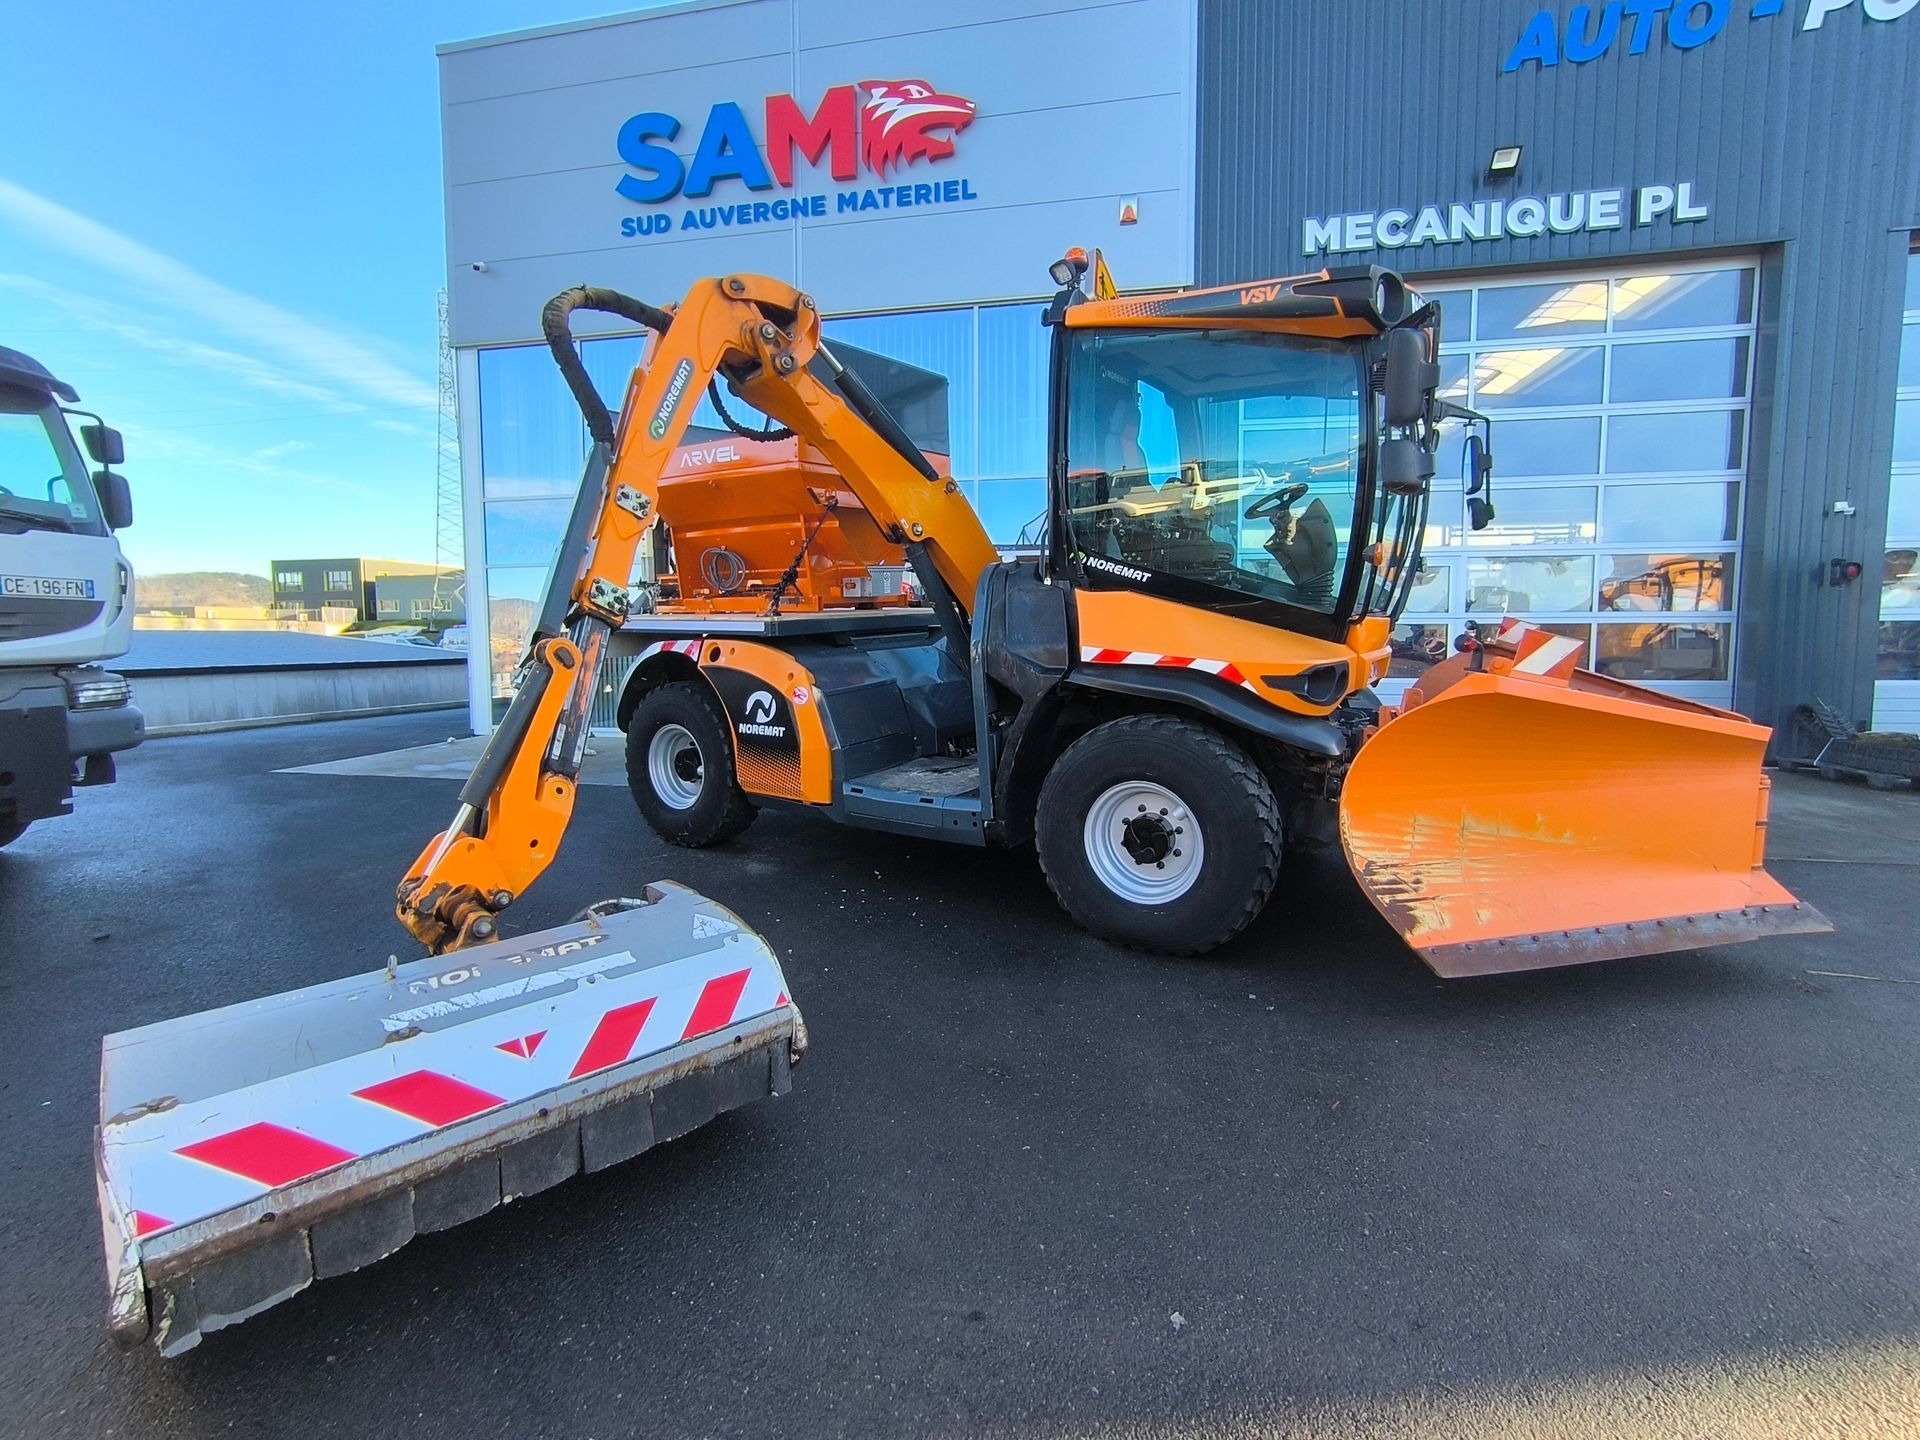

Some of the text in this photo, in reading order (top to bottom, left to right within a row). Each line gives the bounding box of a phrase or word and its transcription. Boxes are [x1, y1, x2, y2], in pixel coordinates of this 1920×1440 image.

[1502, 0, 1732, 72] AUTO
[615, 84, 857, 205] SAM
[621, 179, 977, 237] SUD AUVERGNE MATERIEL
[1303, 182, 1708, 255] MECANIQUE PL
[1240, 284, 1281, 305] VSV
[659, 360, 691, 421] NOREMAT
[680, 445, 740, 468] ARVEL
[4, 577, 84, 596] CE-196-FN
[1086, 556, 1152, 583] NOREMAT
[738, 723, 785, 737] NOREMAT
